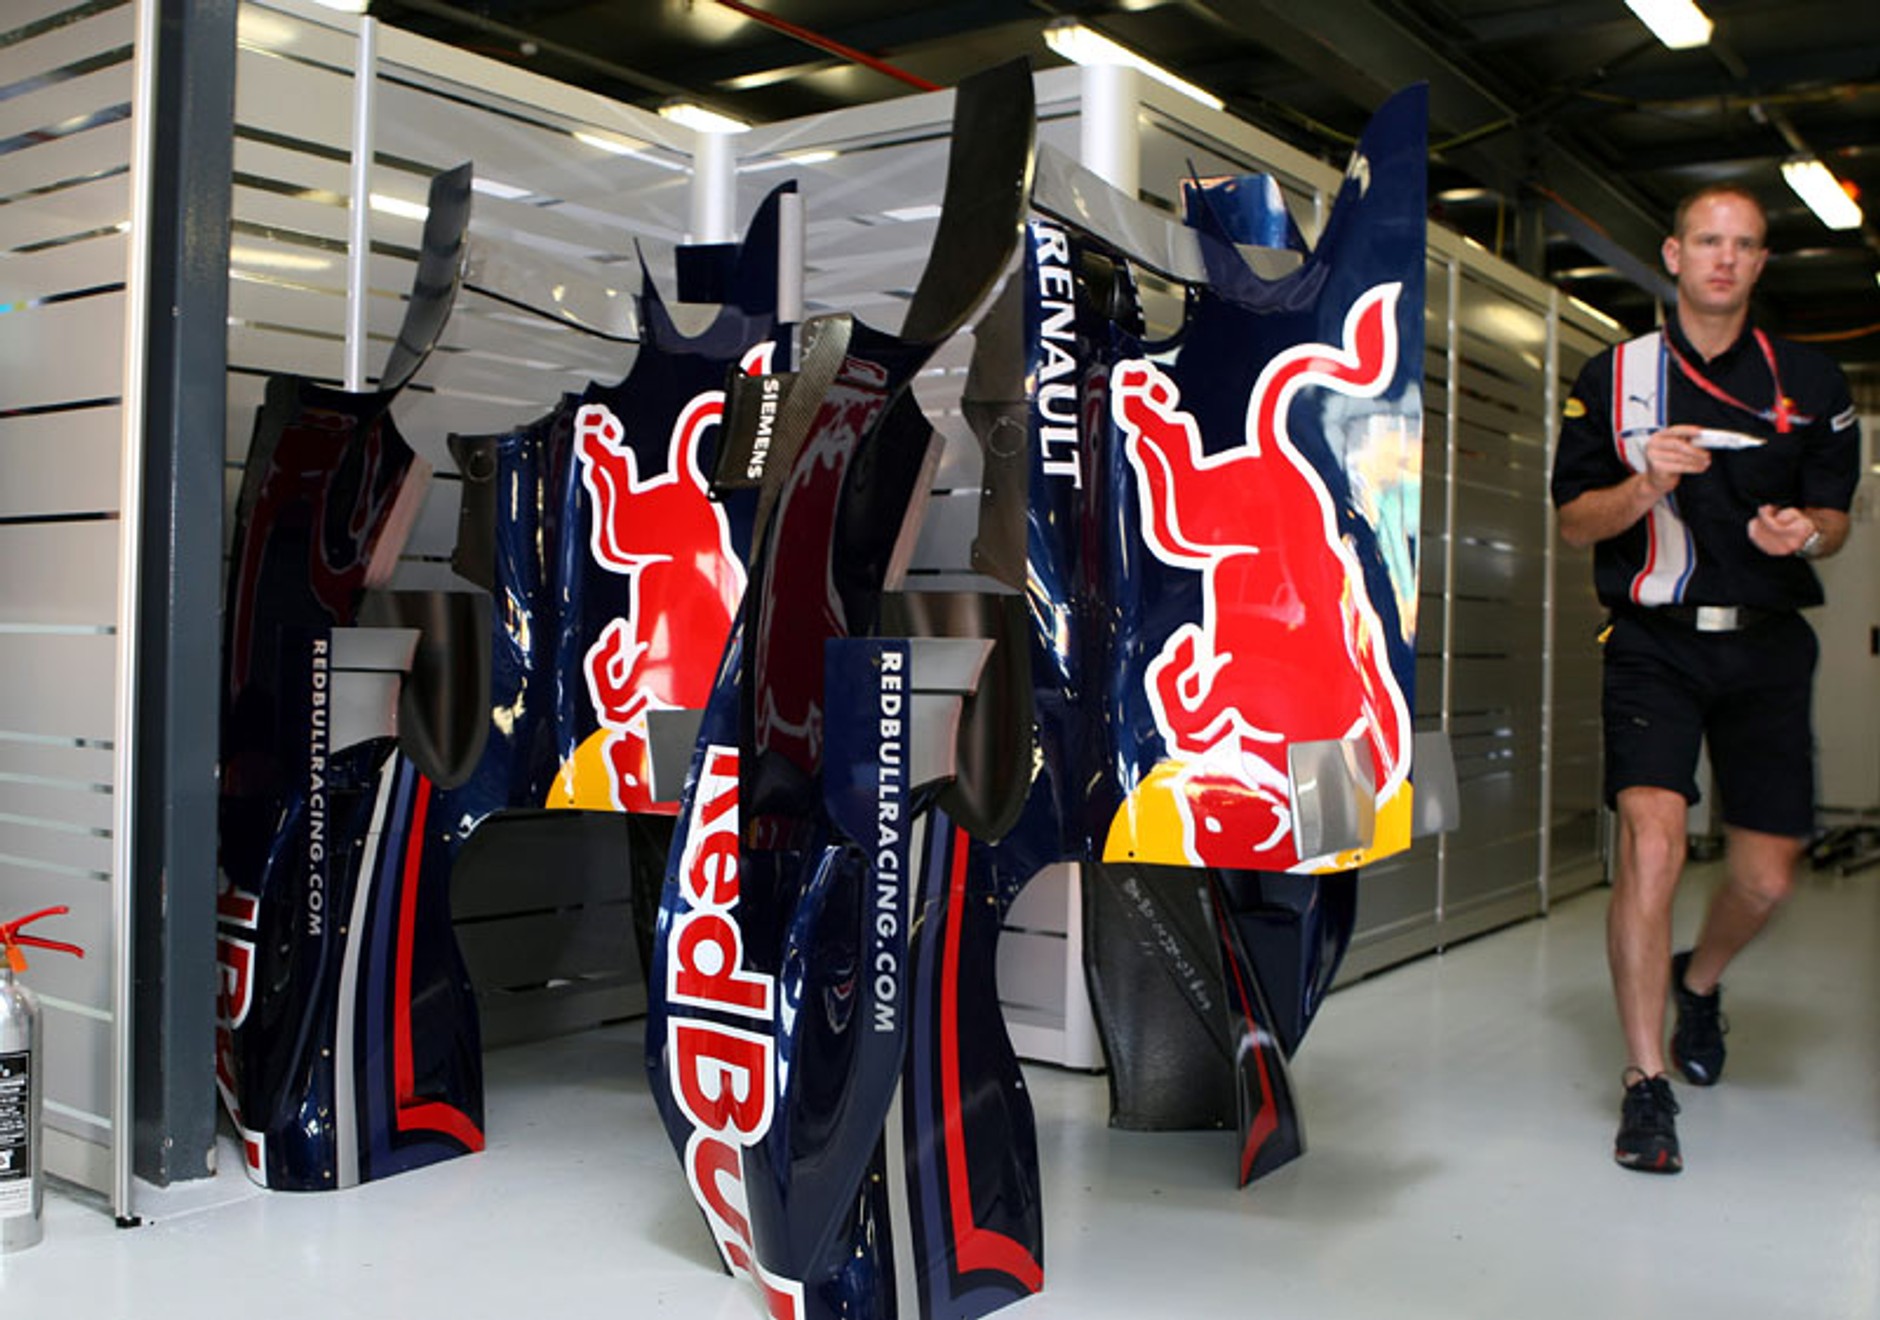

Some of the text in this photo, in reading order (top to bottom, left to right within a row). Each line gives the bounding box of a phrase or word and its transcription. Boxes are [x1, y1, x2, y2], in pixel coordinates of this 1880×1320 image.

[747, 378, 780, 480] SIEMENS
[1034, 226, 1083, 490] RENAULT
[308, 639, 328, 936] REDBULLRACING.COM
[874, 651, 903, 1032] REDBULLRACING.COM
